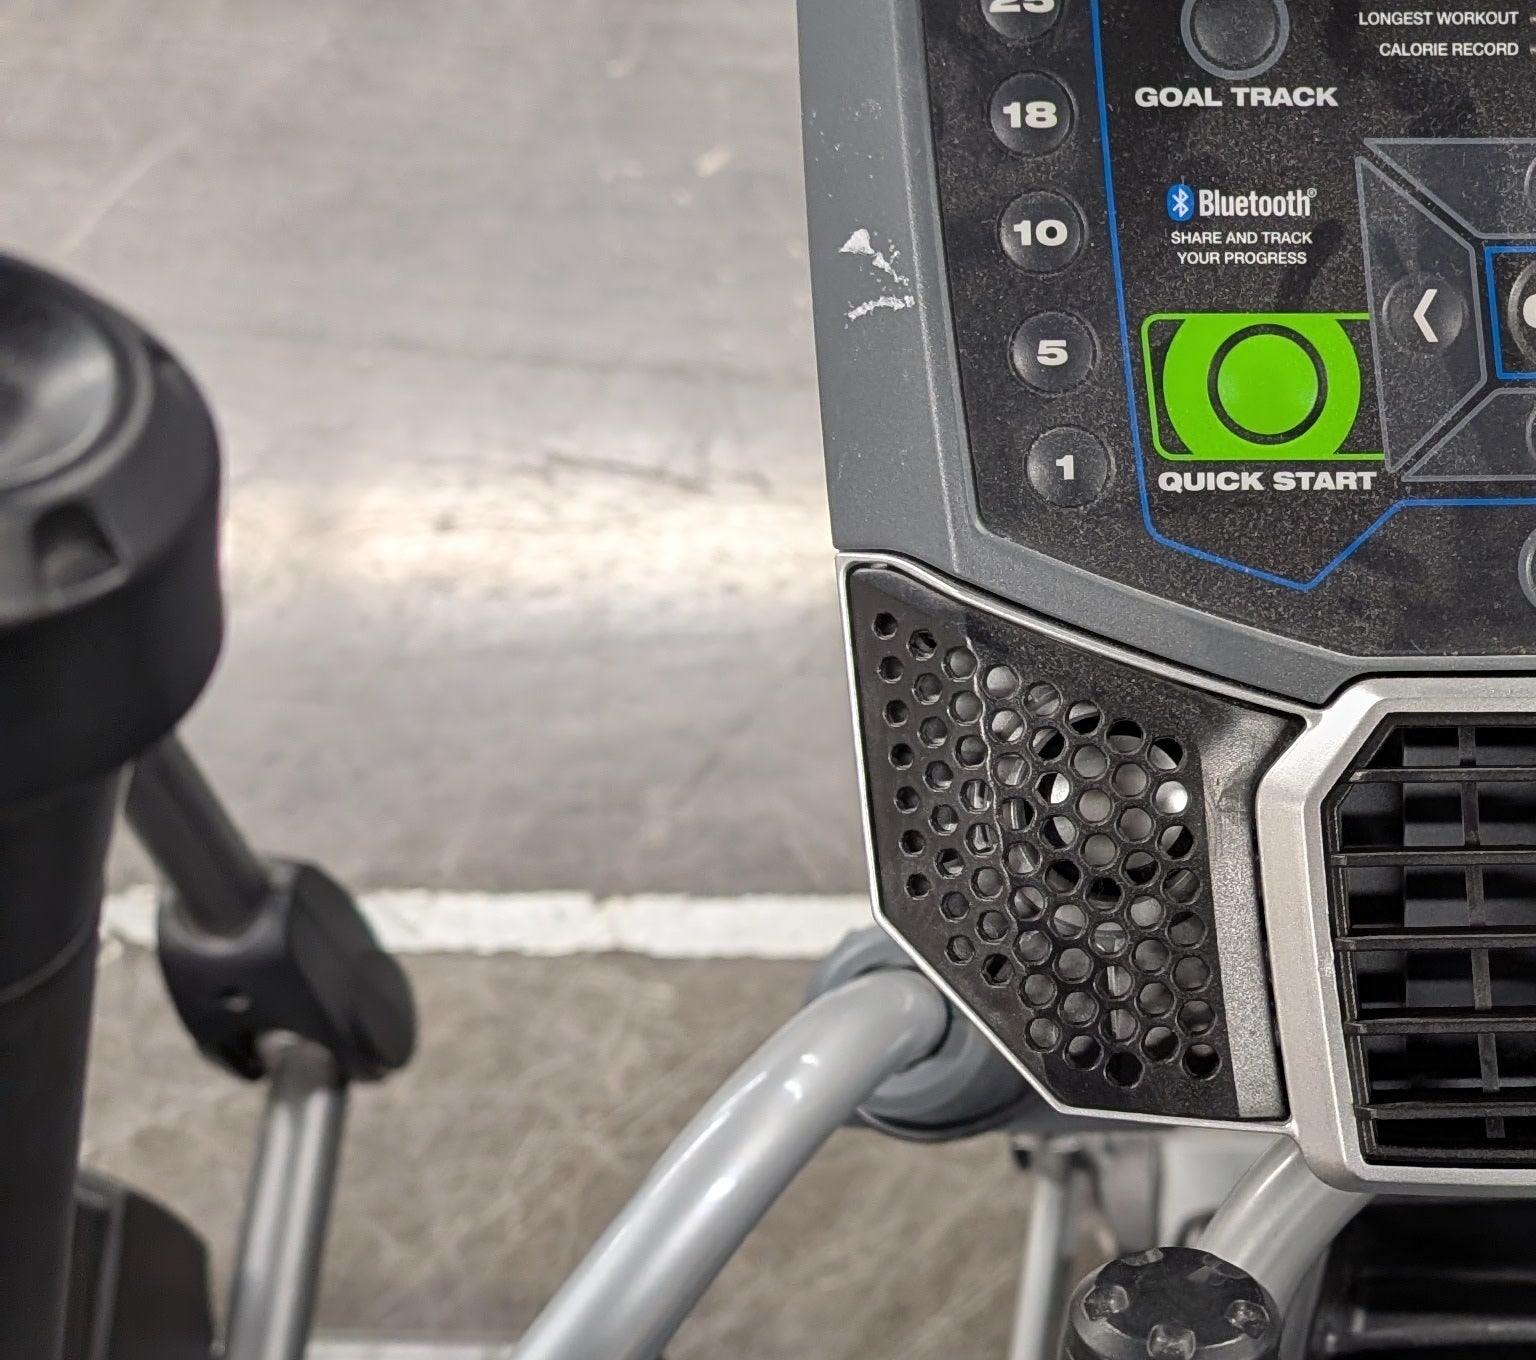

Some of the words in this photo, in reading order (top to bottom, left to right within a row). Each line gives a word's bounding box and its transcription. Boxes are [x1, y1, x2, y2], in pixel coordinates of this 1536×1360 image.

[1358, 11, 1433, 26] LONGEST
[1436, 11, 1520, 26] WORKOUT
[1379, 42, 1448, 57] CALORIE
[1451, 42, 1519, 57] RECORD
[1134, 86, 1223, 108] GOAL
[1230, 86, 1339, 107] TRACK
[1002, 101, 1058, 129] 18
[1011, 219, 1068, 249] 10
[1170, 230, 1222, 245] SHARE
[1225, 231, 1258, 245] AND
[1260, 231, 1313, 245] TRACK
[1176, 251, 1221, 265] YOUR
[1224, 251, 1307, 265] PROGRESS
[1036, 339, 1069, 366] 5
[1055, 454, 1075, 481] 1
[1157, 471, 1265, 494] QUICK
[1272, 471, 1378, 491] START
